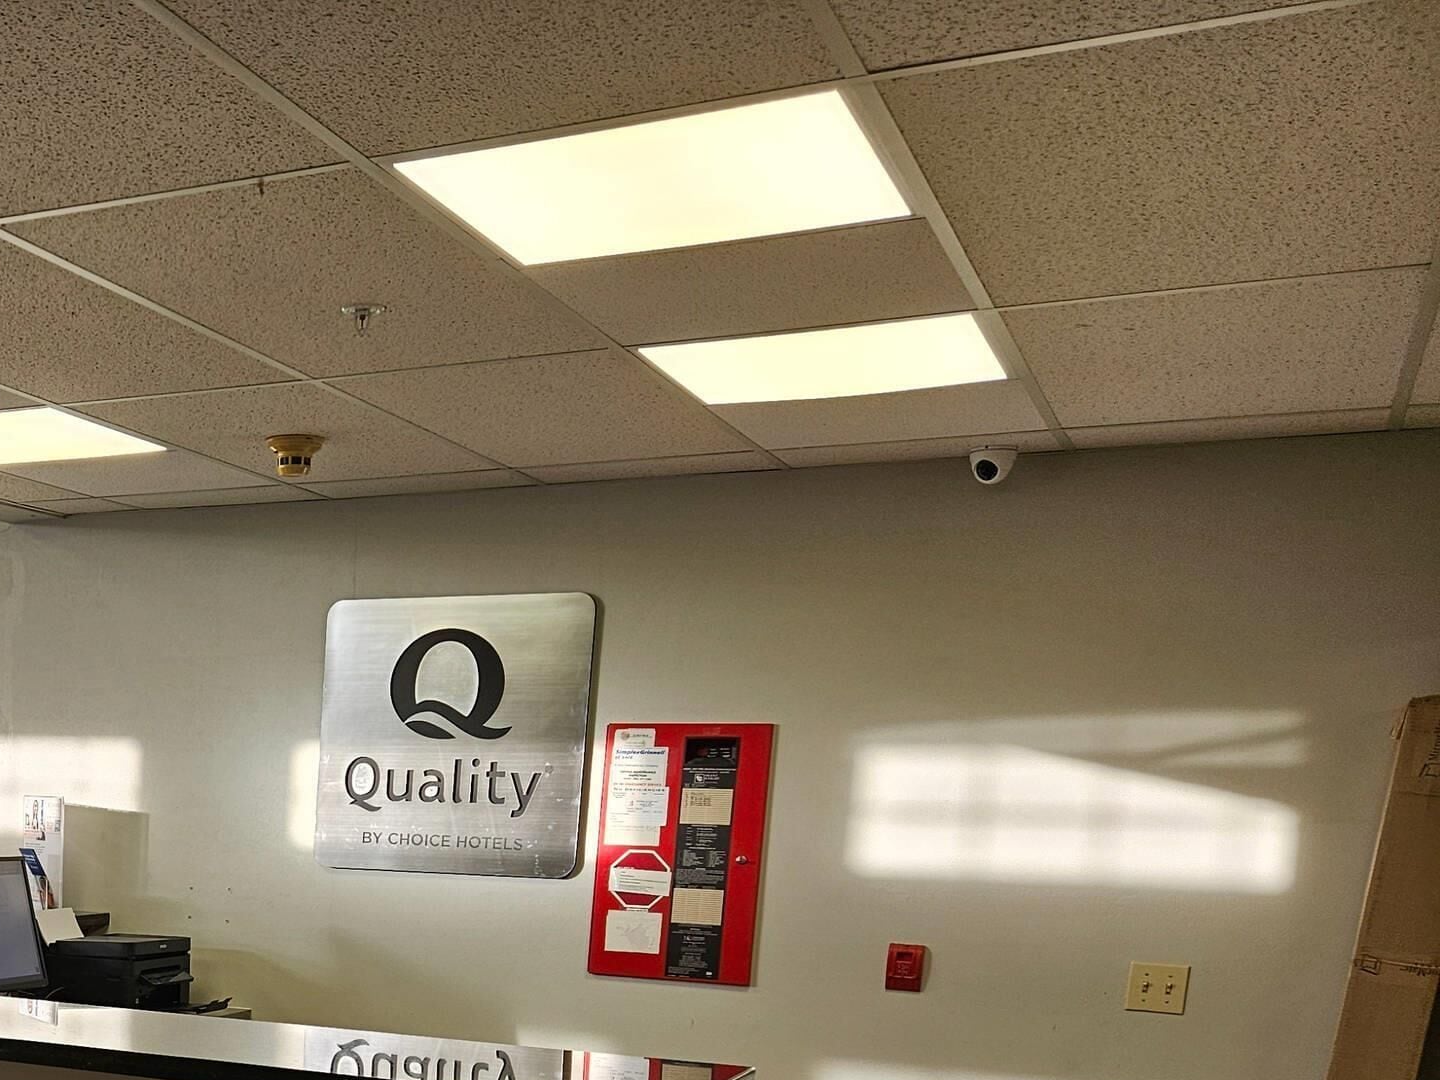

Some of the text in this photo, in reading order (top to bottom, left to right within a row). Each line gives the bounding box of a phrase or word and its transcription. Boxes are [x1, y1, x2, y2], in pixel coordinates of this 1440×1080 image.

[389, 627, 513, 740] Q
[344, 756, 542, 818] Quality
[362, 831, 523, 851] BY CHOICE HOTELS
